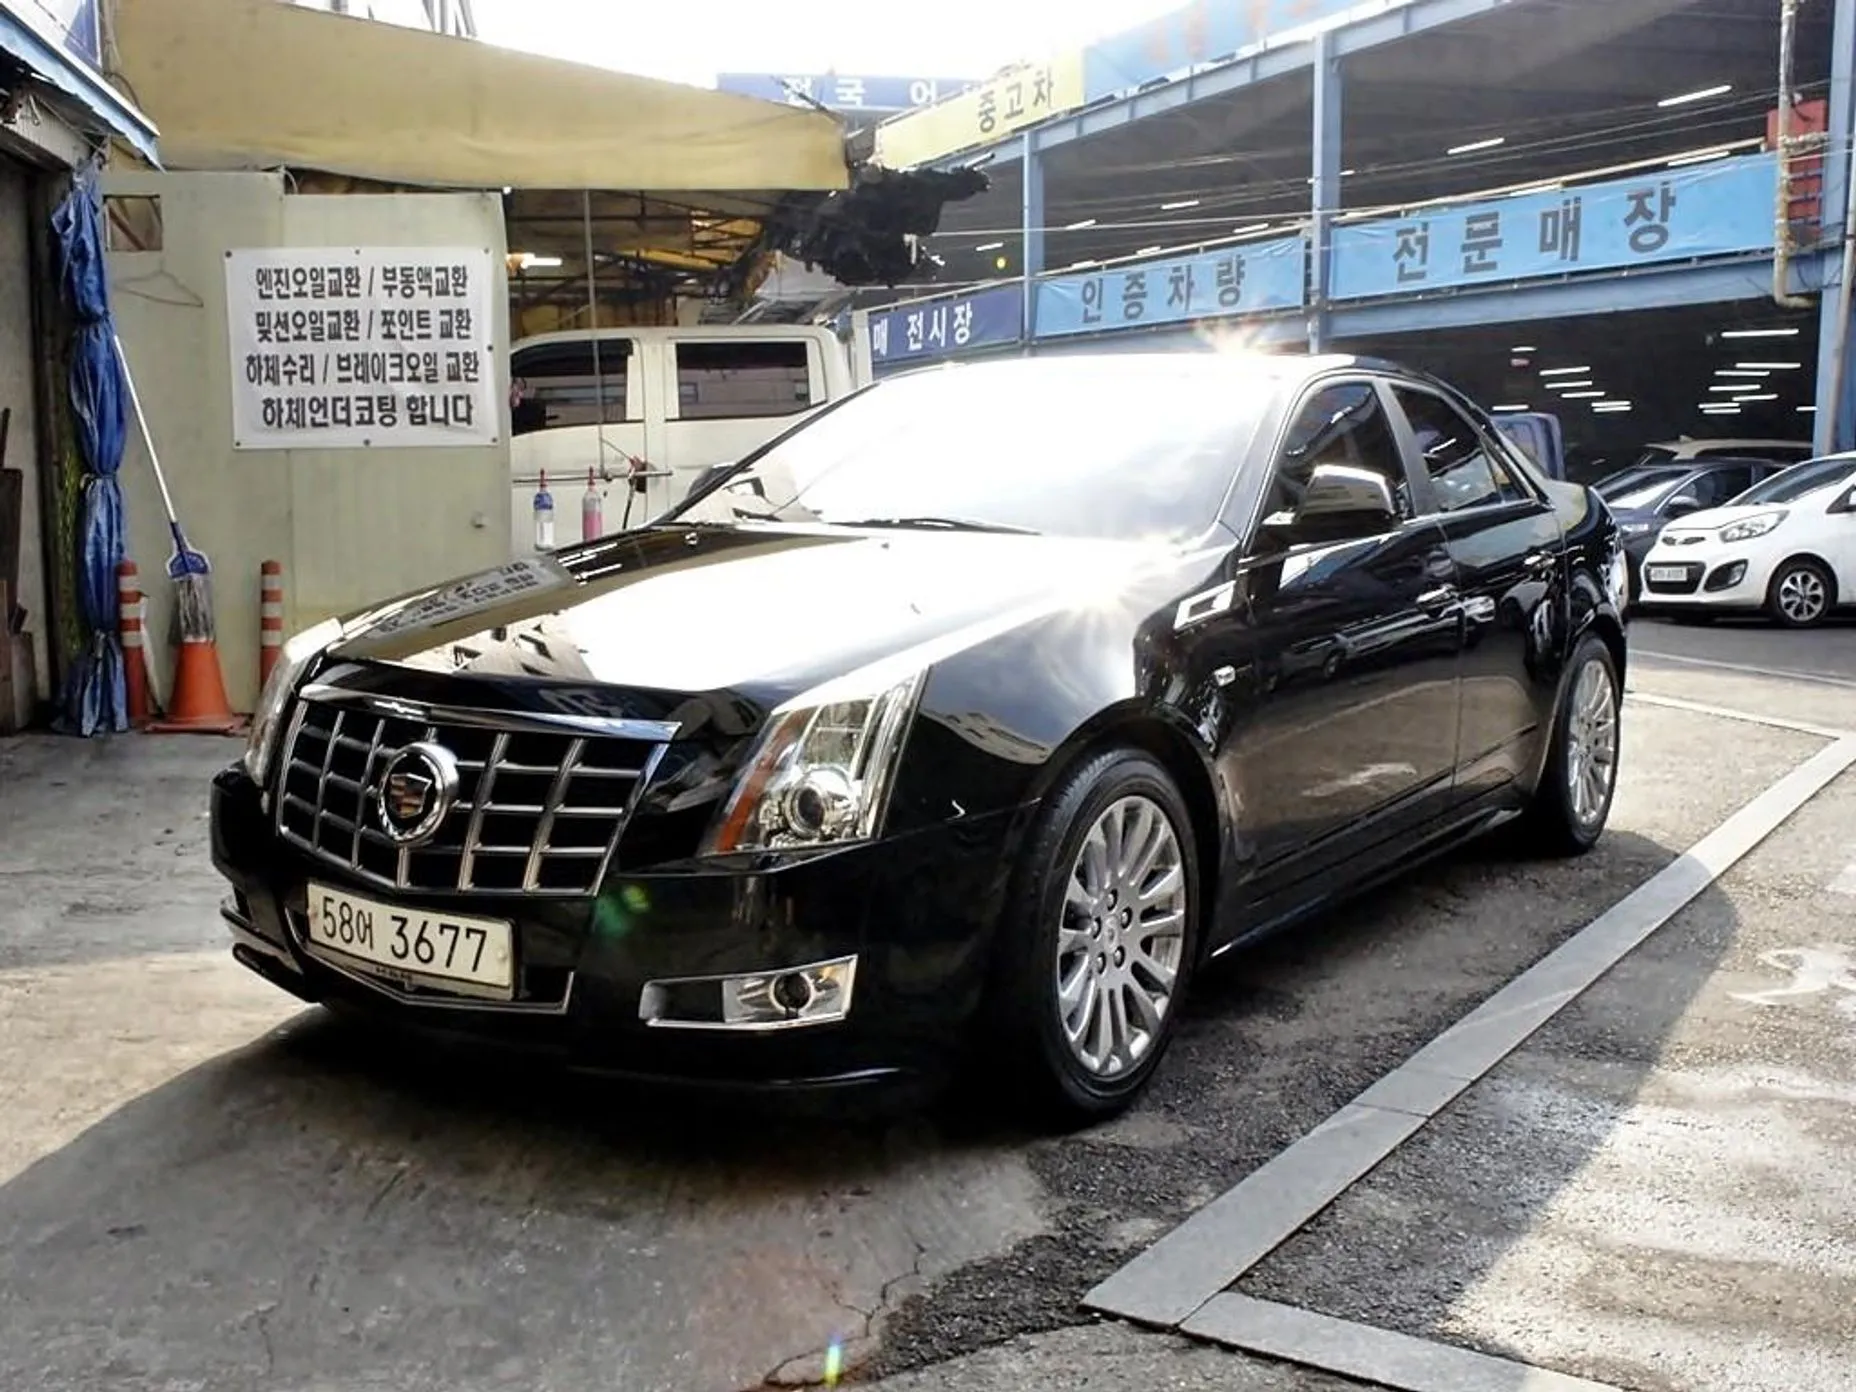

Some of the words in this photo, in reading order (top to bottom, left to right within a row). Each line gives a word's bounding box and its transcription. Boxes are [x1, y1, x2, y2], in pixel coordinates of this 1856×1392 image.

[977, 71, 1054, 133] 중고차
[1392, 181, 1676, 282] 전문매장
[256, 266, 361, 300] 엔진오일교환
[382, 266, 468, 299] 부동액교환
[1081, 254, 1246, 324] 인증차량
[439, 308, 472, 340] 교환
[906, 302, 973, 351] 전시장
[246, 353, 315, 386] 하체수리
[336, 352, 439, 384] 브레이크오일
[446, 351, 479, 383] 교환
[262, 395, 397, 428] 하체언더코팅
[406, 394, 473, 426] 합니다
[322, 896, 374, 950] 58어
[391, 915, 487, 972] 3677
